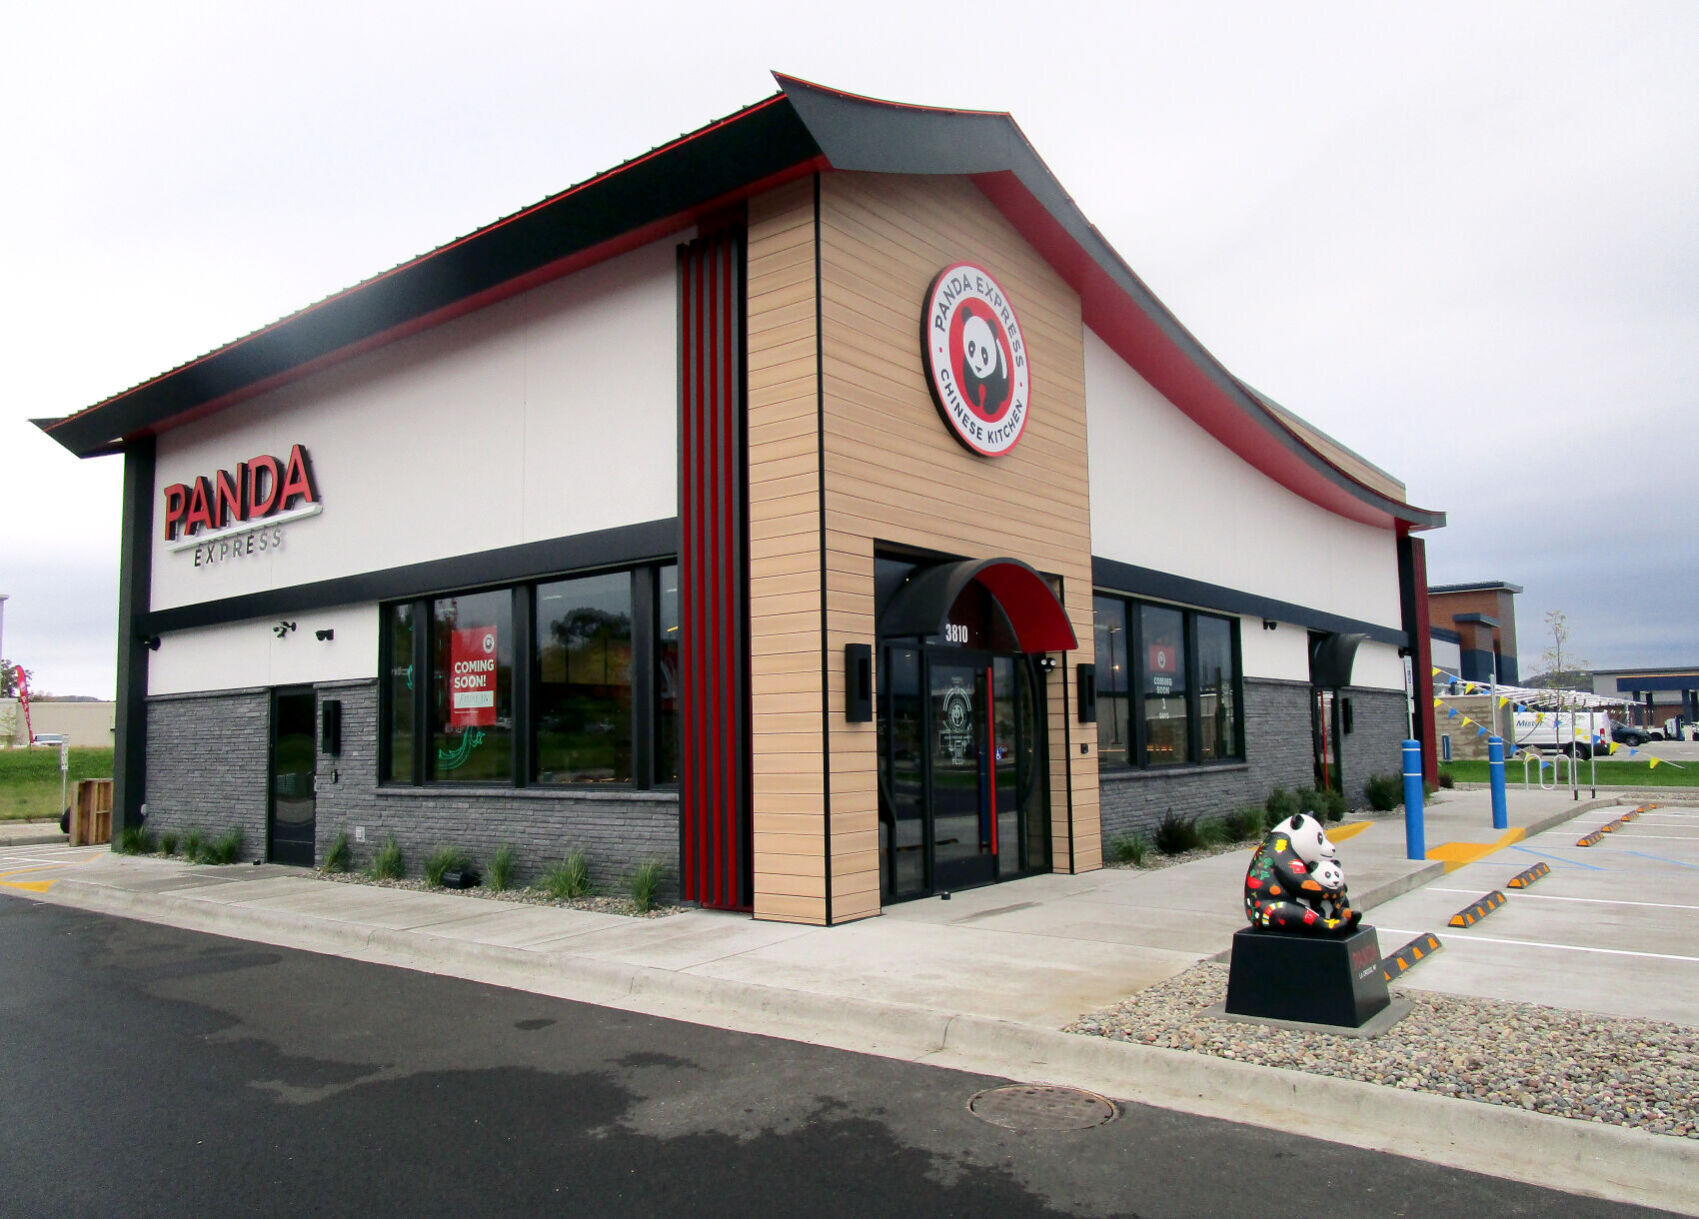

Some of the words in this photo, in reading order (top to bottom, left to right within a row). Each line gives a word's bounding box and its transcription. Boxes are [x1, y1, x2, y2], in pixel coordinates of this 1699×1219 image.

[935, 273, 973, 333] PANDA
[976, 276, 1024, 368] EXPRESS
[940, 368, 983, 441] CHINESE
[987, 399, 1023, 444] KITCHEN
[164, 444, 317, 541] PANDA
[194, 529, 282, 567] EXPRESS
[945, 624, 969, 643] 3810
[454, 659, 495, 674] COMING
[454, 675, 487, 688] SOON!
